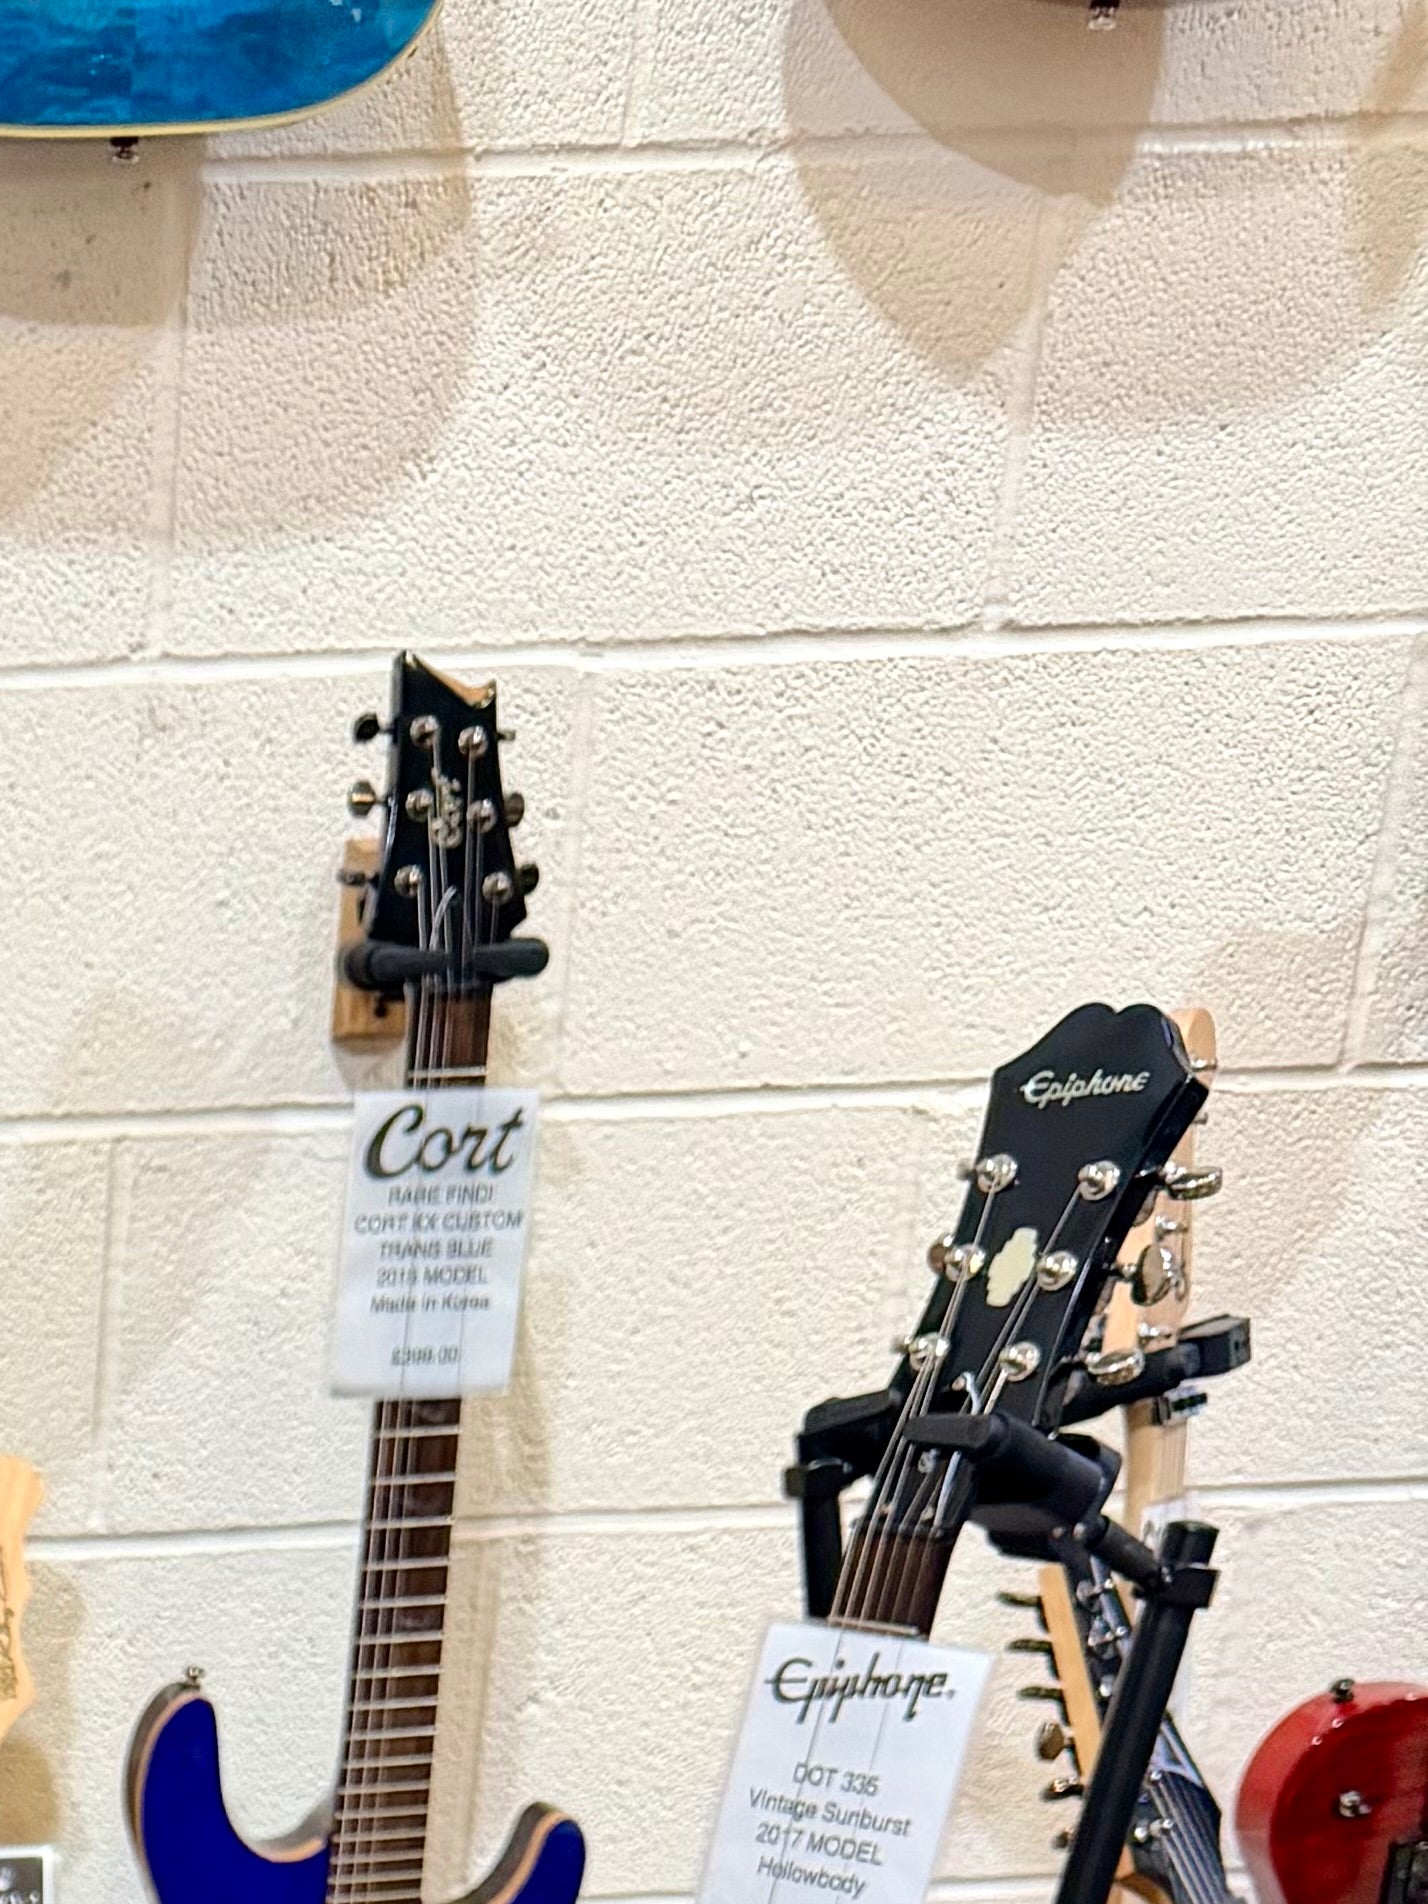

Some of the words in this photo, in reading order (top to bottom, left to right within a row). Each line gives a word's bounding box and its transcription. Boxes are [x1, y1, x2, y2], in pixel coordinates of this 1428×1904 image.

[1020, 1068, 1150, 1109] Epiphone
[363, 1103, 524, 1181] Cort
[354, 1214, 408, 1236] CORT
[442, 1210, 524, 1233] CUSTOM
[444, 1239, 493, 1259] BLUE
[422, 1265, 489, 1286] MODEL
[792, 1762, 840, 1790] DOT
[841, 1768, 881, 1797] 335
[749, 1787, 820, 1823] Vintage
[821, 1802, 912, 1838] Sunburst
[755, 1822, 805, 1853] 2017
[805, 1832, 884, 1866] MODEL
[757, 1856, 867, 1901] Hollowbody
